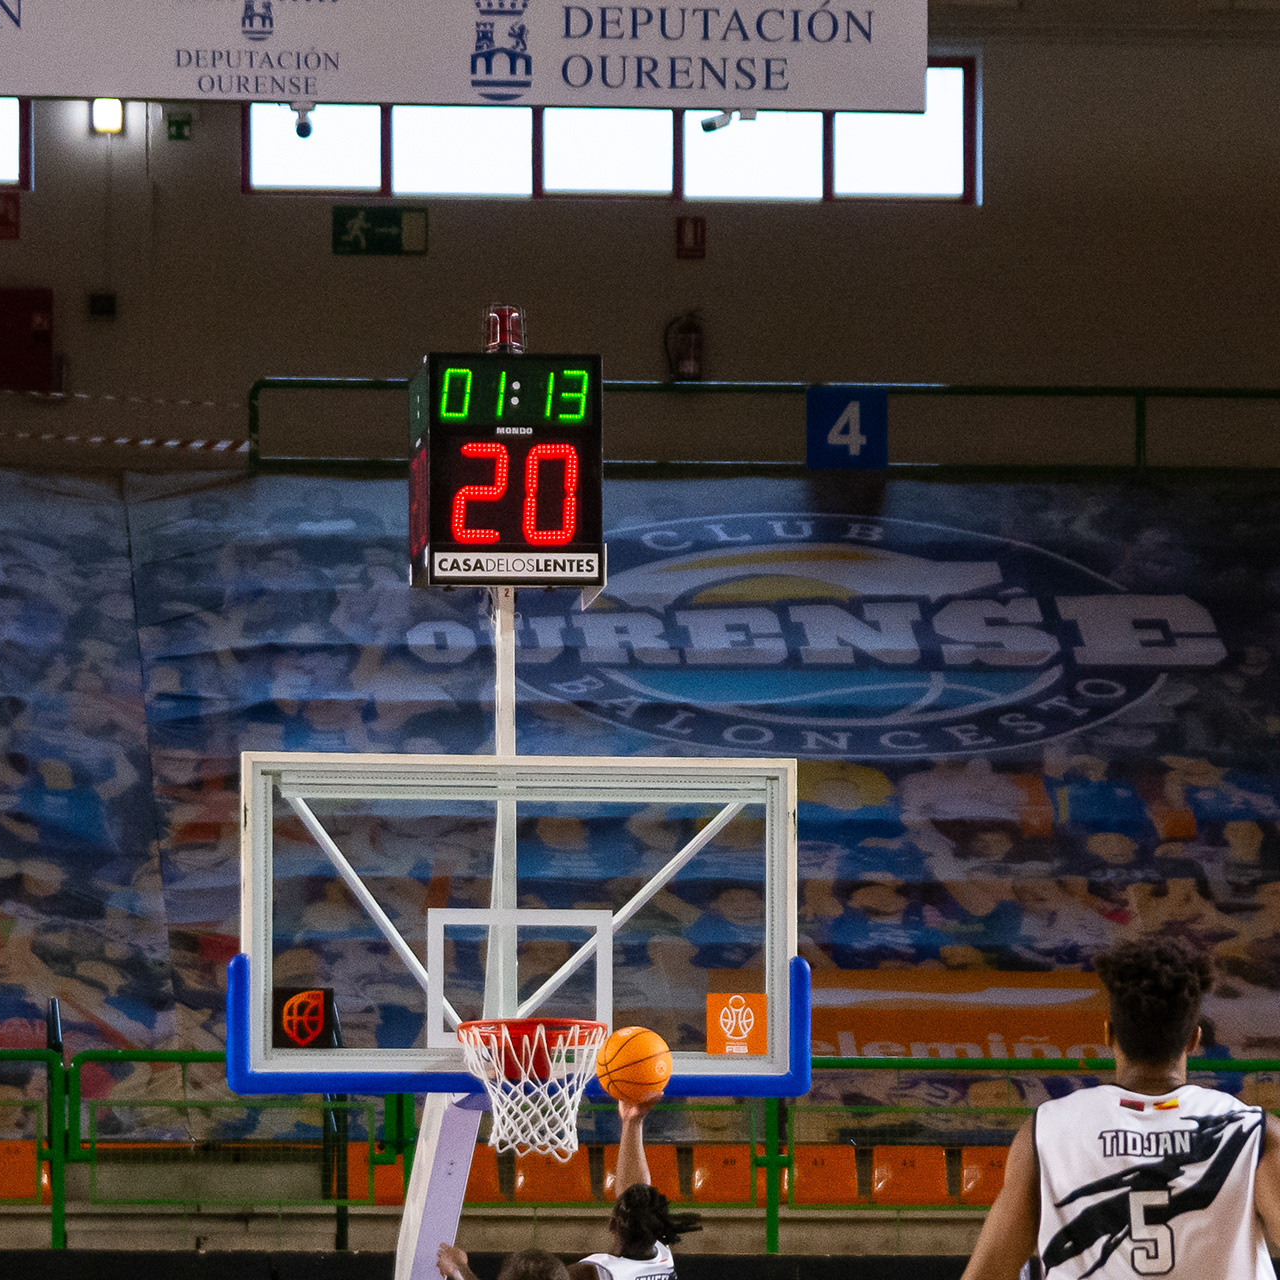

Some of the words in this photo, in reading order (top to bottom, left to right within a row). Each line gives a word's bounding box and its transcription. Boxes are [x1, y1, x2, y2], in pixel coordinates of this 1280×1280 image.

[561, 3, 875, 45] DEPUTACIÓN
[175, 47, 340, 71] DEPUTACIÓN
[561, 55, 791, 92] OURENSE
[197, 74, 318, 95] OURENSE
[440, 368, 588, 421] 01:13
[496, 427, 533, 435] MONDO
[827, 401, 867, 455] 4
[452, 442, 578, 545] 20
[642, 515, 886, 551] CLUB
[407, 593, 1229, 667] OURENSE
[548, 674, 1131, 752] BALONCESTO
[1097, 1129, 1192, 1158] TIDJAN
[1126, 1191, 1175, 1276] 5
